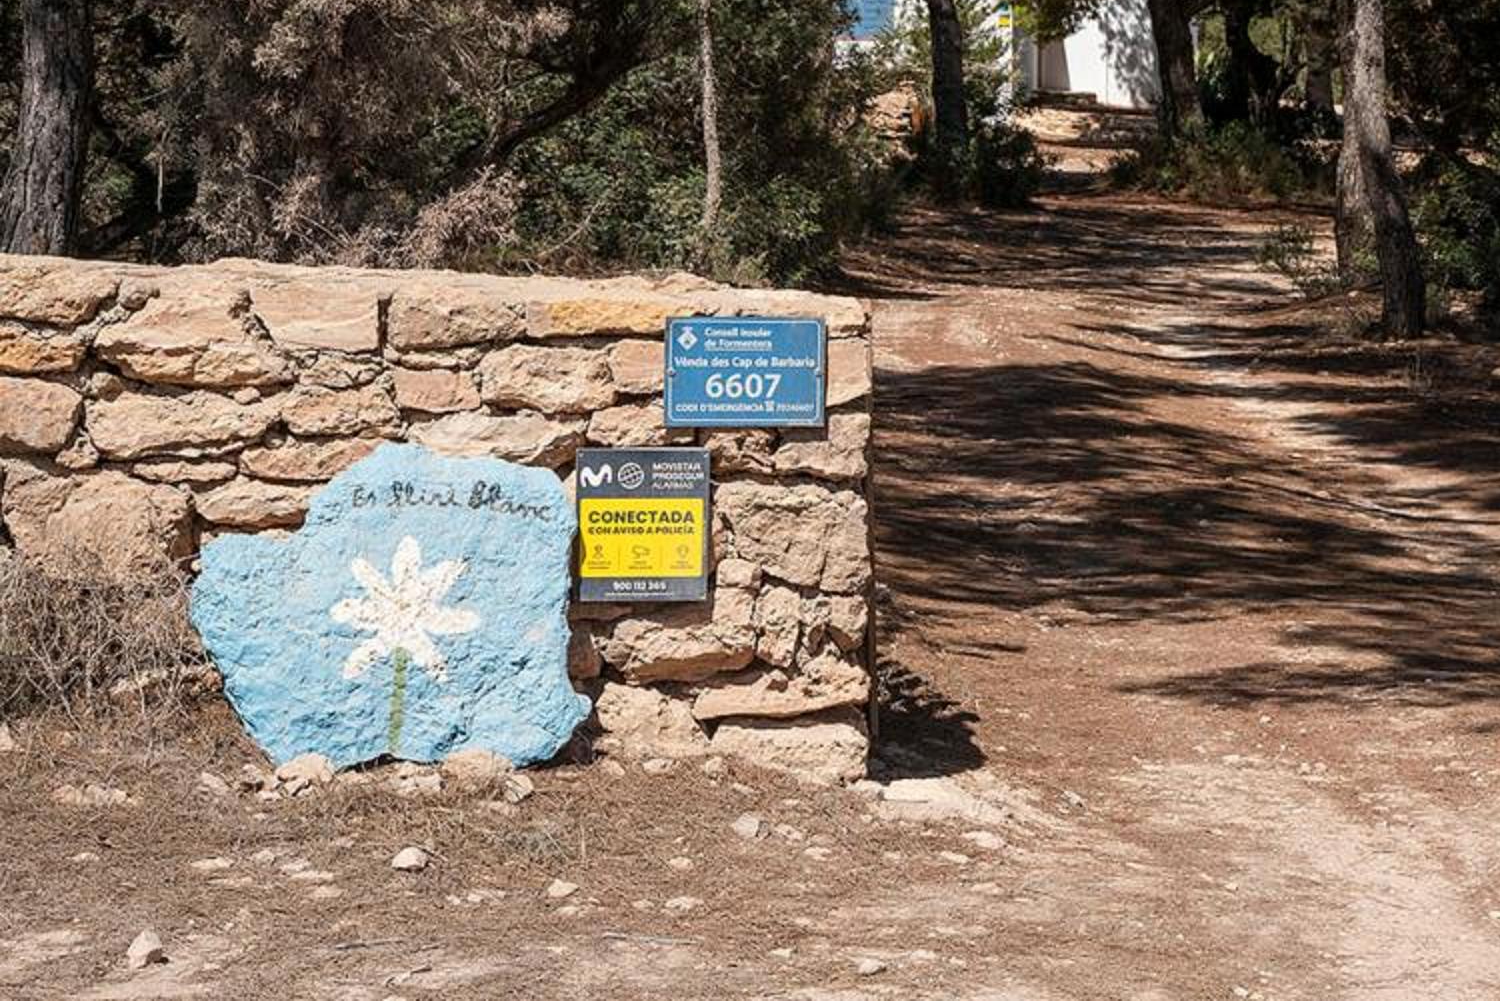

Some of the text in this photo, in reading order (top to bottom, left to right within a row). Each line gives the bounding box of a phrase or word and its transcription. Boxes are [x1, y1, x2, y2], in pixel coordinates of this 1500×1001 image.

[704, 327, 771, 337] Consell Insular
[704, 339, 772, 348] de Formentera
[711, 356, 729, 367] des
[732, 357, 752, 369] Cap
[754, 356, 769, 367] de
[705, 374, 781, 399] 6607
[652, 462, 701, 471] MOVISTAR
[652, 472, 705, 480] PROSEGUR
[652, 481, 695, 489] ALARMAS
[588, 510, 695, 524] CONECTADA
[588, 526, 610, 535] CON
[611, 526, 645, 535] AVISO
[646, 526, 653, 535] A
[613, 581, 632, 591] 900
